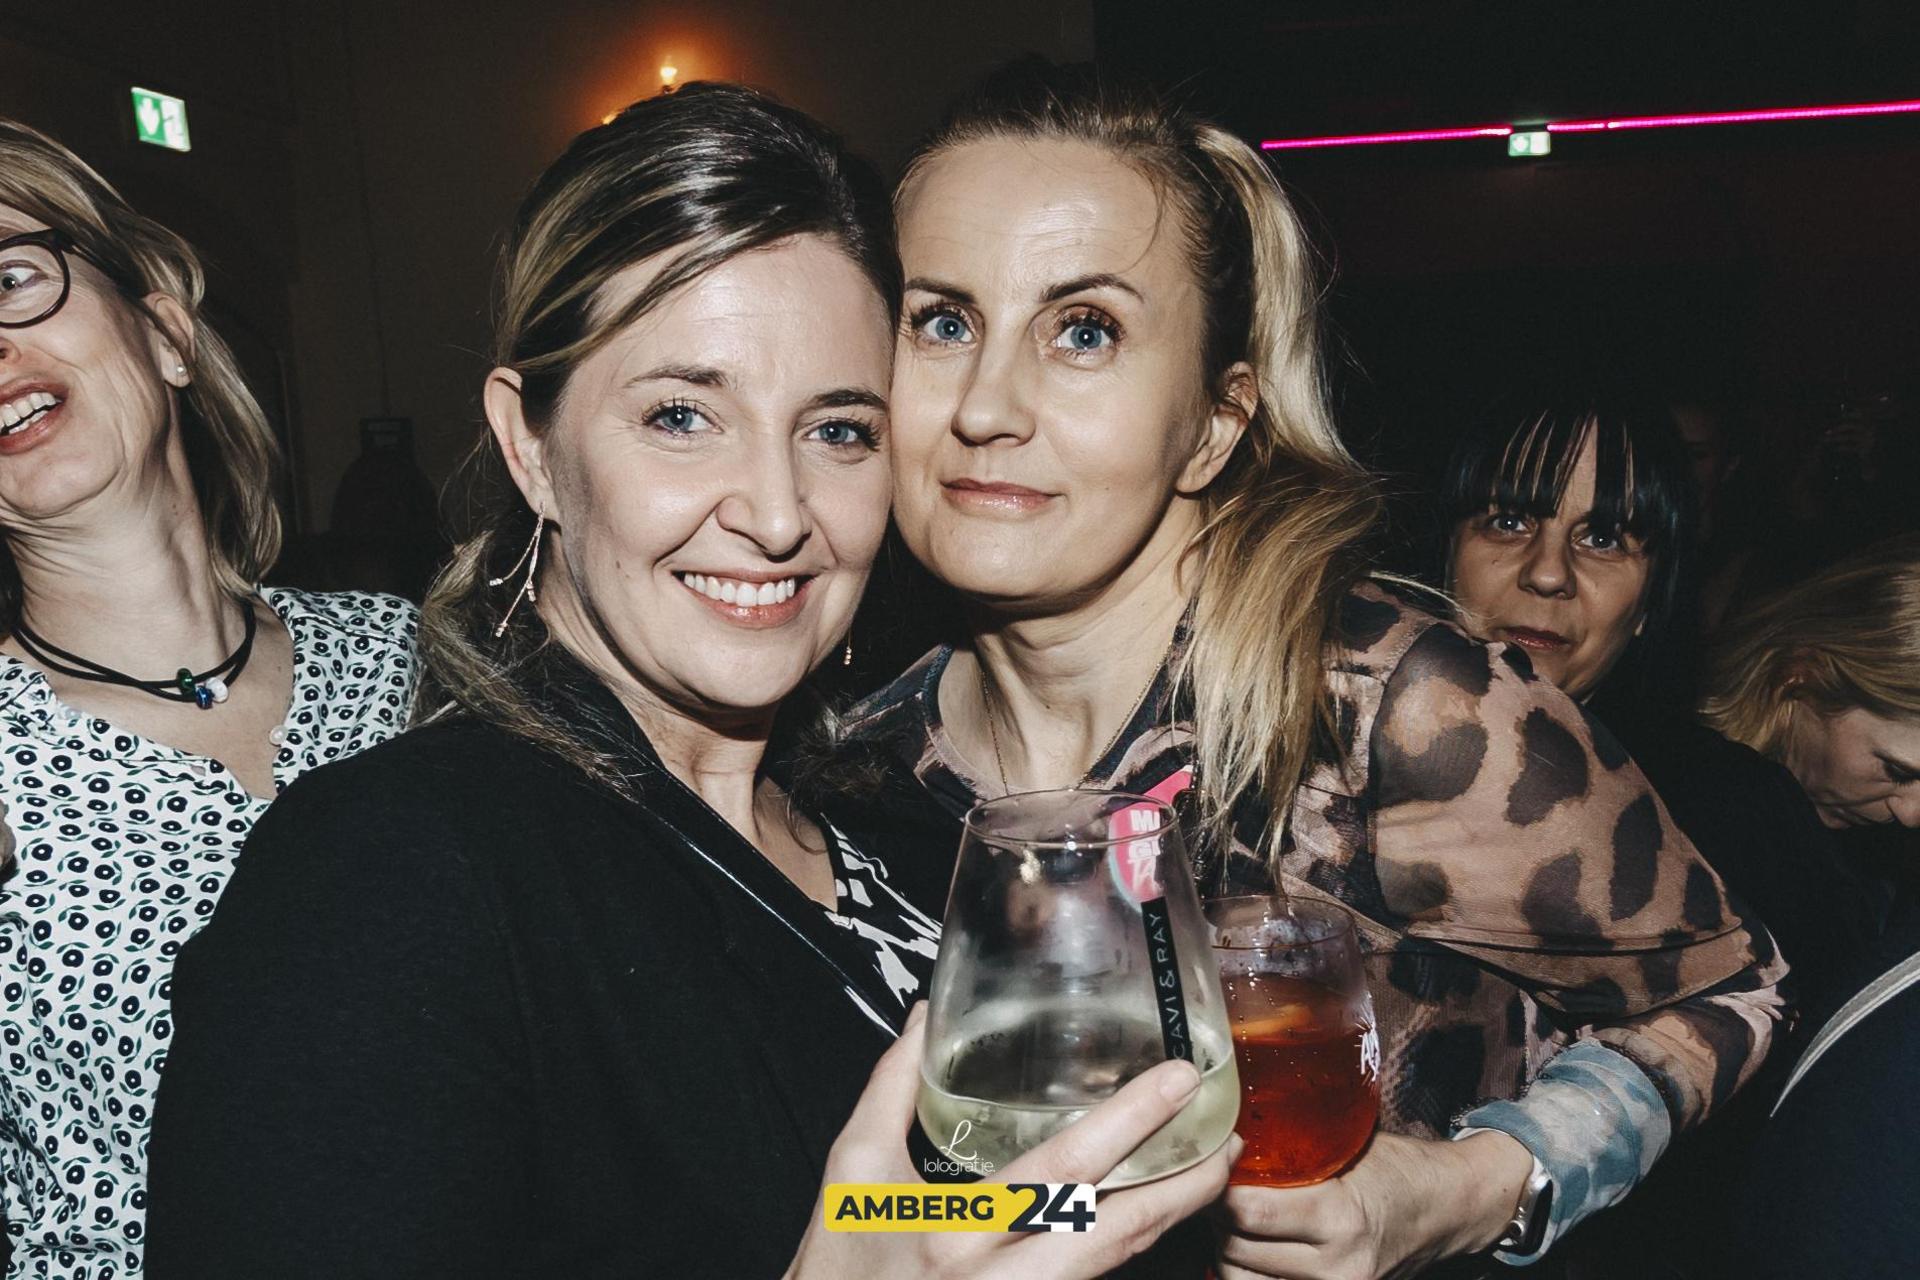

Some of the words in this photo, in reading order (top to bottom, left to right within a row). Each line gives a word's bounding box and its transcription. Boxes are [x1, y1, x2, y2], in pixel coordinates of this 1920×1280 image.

[1149, 912, 1169, 963] RAY
[1159, 969, 1176, 988] &
[1164, 996, 1186, 1060] CAVI
